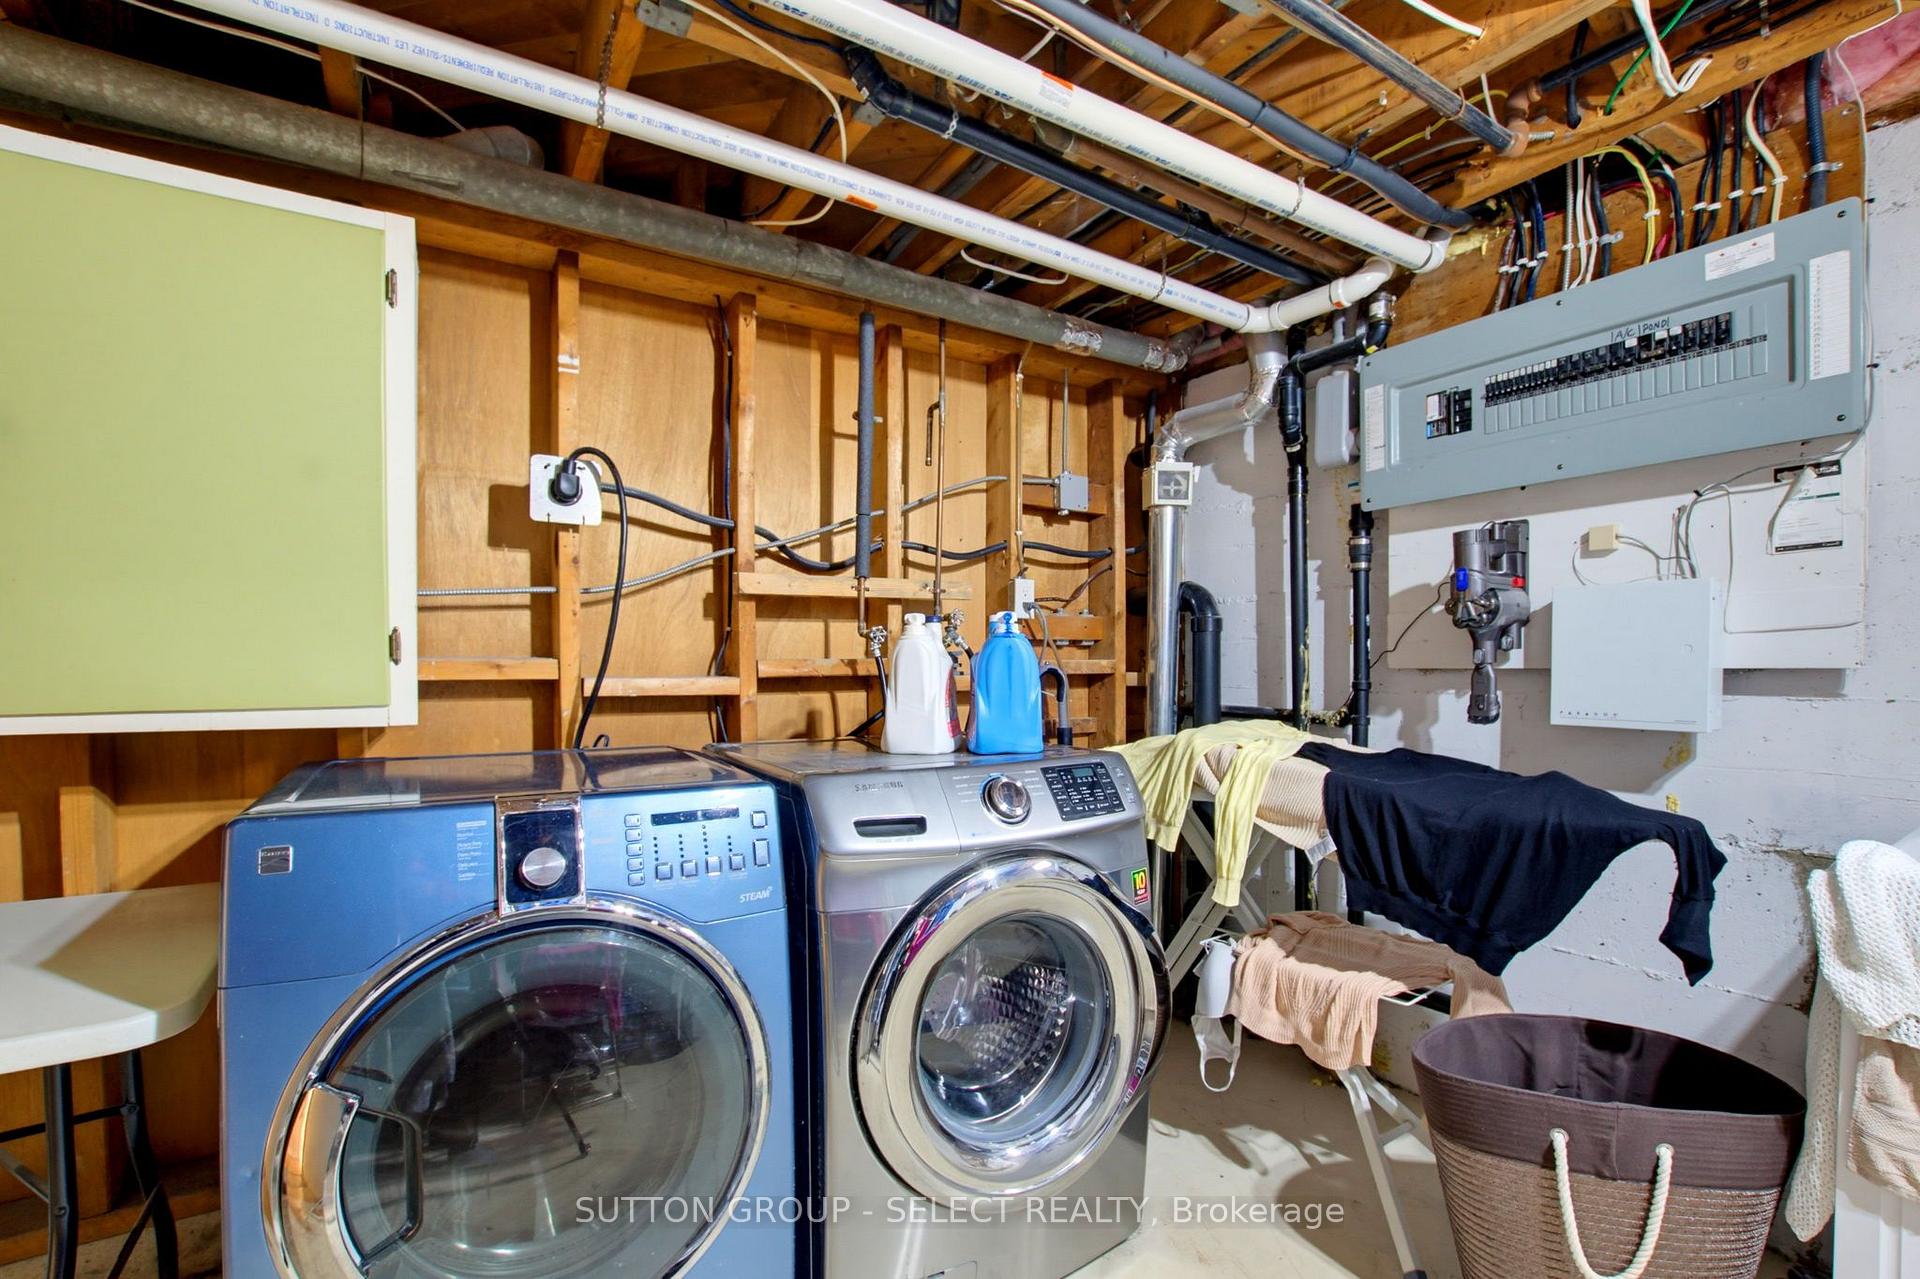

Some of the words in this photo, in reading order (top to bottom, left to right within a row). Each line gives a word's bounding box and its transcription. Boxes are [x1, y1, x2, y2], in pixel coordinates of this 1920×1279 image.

[333, 20, 390, 45] INSTRUCTIONS
[393, 39, 409, 51] LES
[496, 70, 545, 93] INSTALLATION
[1133, 871, 1146, 890] 10
